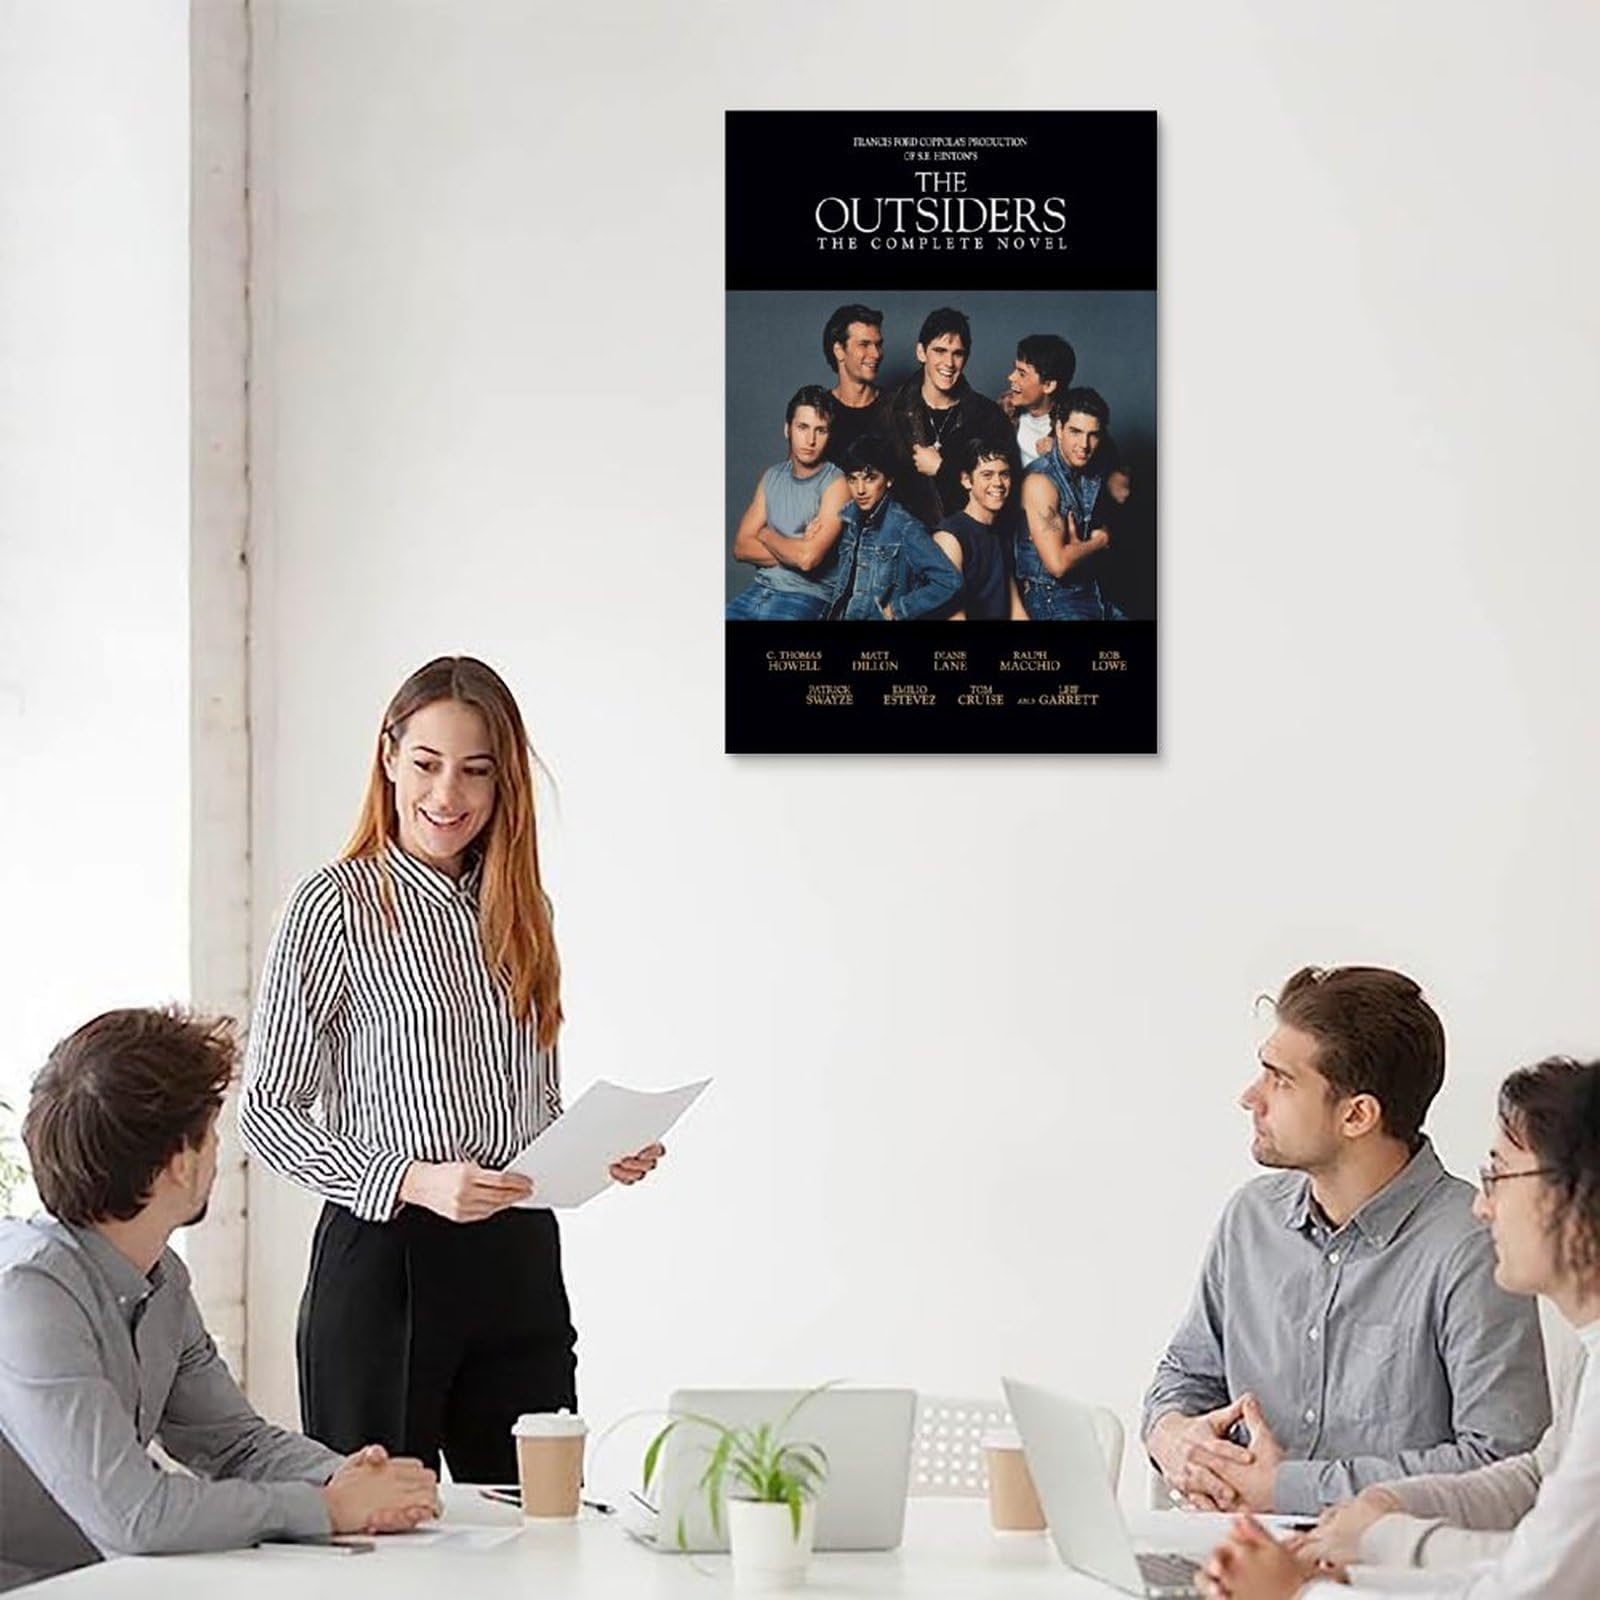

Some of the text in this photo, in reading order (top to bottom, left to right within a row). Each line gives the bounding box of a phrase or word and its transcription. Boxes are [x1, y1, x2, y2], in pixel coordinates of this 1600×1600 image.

[894, 137, 918, 147] FORD
[968, 137, 1028, 147] PRODUCTION
[914, 171, 968, 193] THE
[814, 196, 1067, 234] OUTSIDERS
[817, 237, 1068, 250] THE COMPLETE NOVEL
[779, 651, 822, 660] THOMAS
[861, 651, 890, 660] MATT
[1013, 651, 1047, 660] RALPH
[768, 660, 821, 671] HOWELL
[852, 660, 899, 671] DILLON
[933, 660, 967, 671] LANE
[1000, 660, 1061, 671] MACCHIO
[1092, 660, 1127, 671] LOWE
[806, 694, 854, 705] SWAYZE
[883, 694, 936, 705] ESTEVEZ
[957, 694, 1004, 705] CRUISE
[1038, 694, 1099, 706] GARRETT
